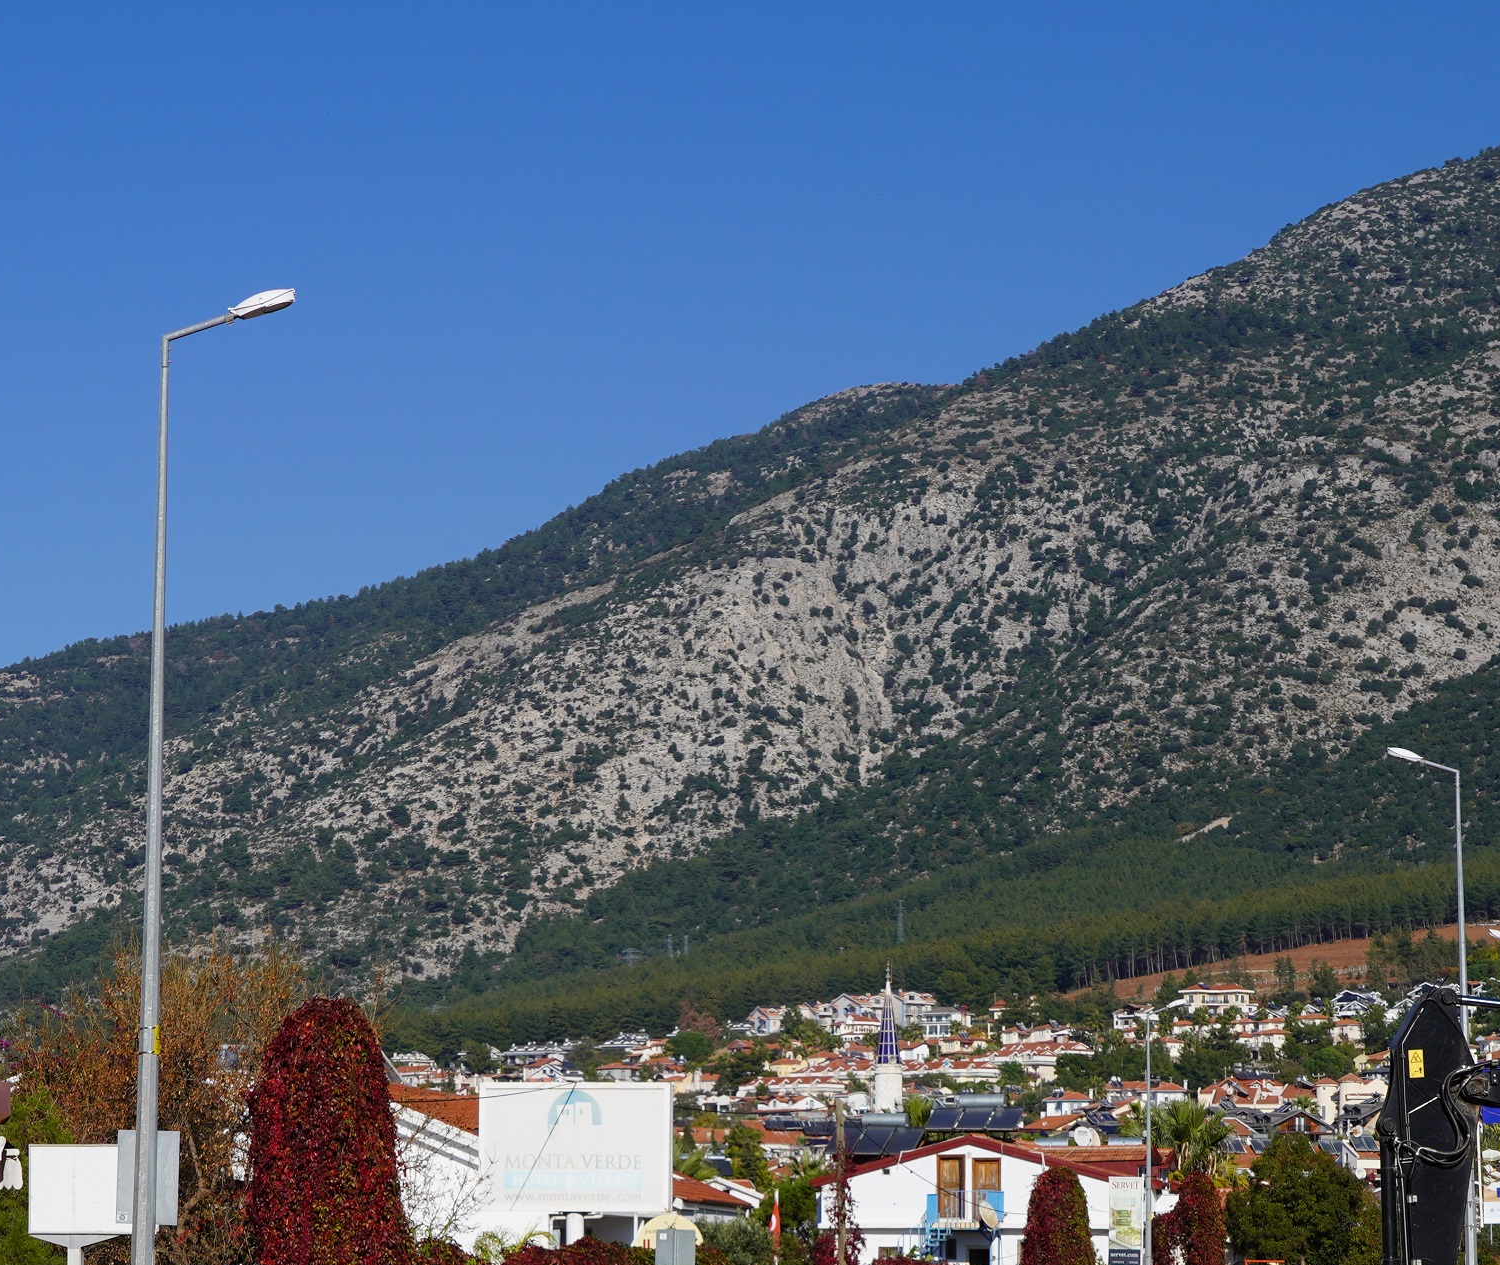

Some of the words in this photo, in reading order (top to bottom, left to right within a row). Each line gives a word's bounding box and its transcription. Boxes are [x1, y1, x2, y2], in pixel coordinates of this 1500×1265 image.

[504, 1153, 575, 1169] MONTA
[581, 1153, 642, 1169] VERDE
[513, 1173, 559, 1185] HOTEL
[1112, 1181, 1139, 1190] SERVET
[504, 1191, 642, 1202] www.montaverde.com
